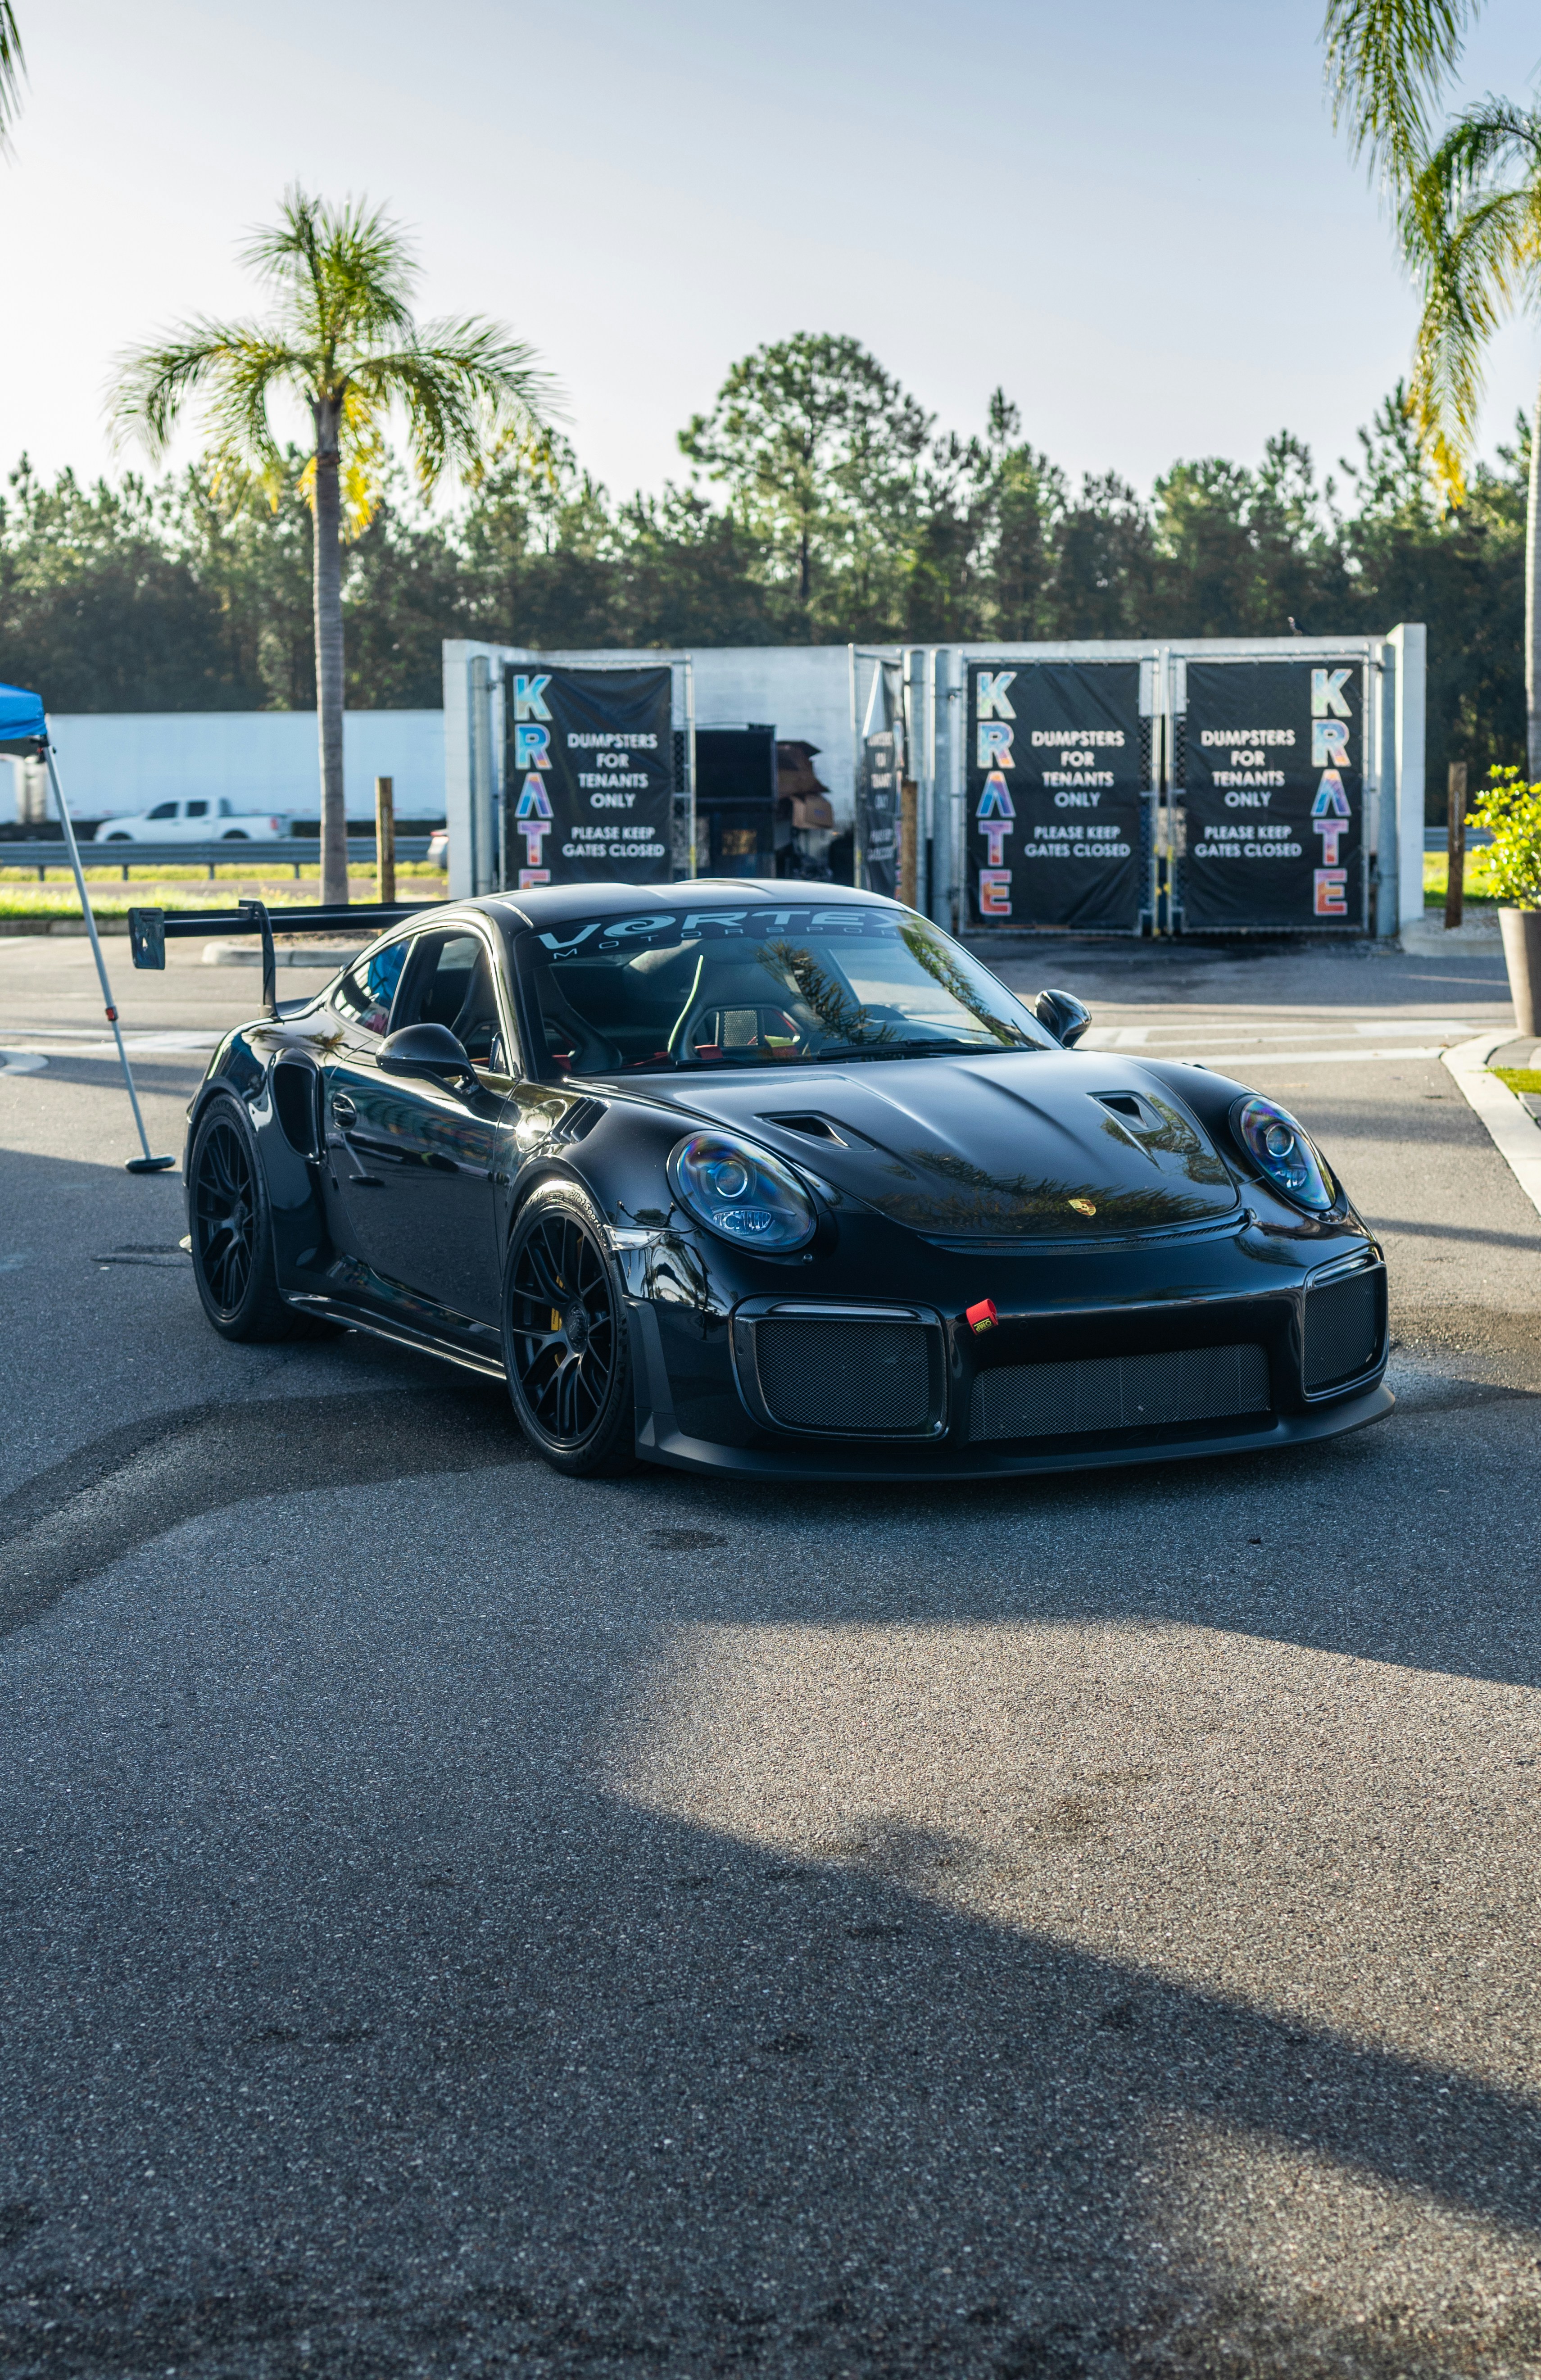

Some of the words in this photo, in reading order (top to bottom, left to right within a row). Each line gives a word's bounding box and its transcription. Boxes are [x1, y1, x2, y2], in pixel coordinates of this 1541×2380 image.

[567, 733, 658, 749] DUMPSTERS
[1032, 731, 1125, 747] DUMPSTERS
[1201, 730, 1296, 746] DUMPSTERS
[596, 753, 629, 768] FOR
[1061, 751, 1095, 767] FOR
[1231, 750, 1265, 766] FOR
[578, 773, 648, 789] TENANTS
[1042, 771, 1115, 787] TENANTS
[1212, 771, 1285, 787] TENANTS
[590, 793, 636, 808] ONLY
[976, 671, 1017, 916] KRATE
[1054, 792, 1101, 807] ONLY
[1224, 792, 1272, 807] ONLY
[1310, 669, 1354, 916] KRATE
[571, 827, 620, 840] PLEASE
[622, 827, 655, 841] KEEP
[1034, 826, 1084, 840] PLEASE
[1086, 826, 1121, 840] KEEP
[1204, 826, 1255, 840] PLEASE
[1257, 826, 1292, 840] KEEP
[562, 843, 606, 857] GATES
[609, 843, 665, 857] CLOSED
[1024, 843, 1070, 858] GATES
[1073, 843, 1131, 858] CLOSED
[1194, 843, 1241, 858] GATES
[1243, 843, 1302, 858] CLOSED
[530, 911, 922, 949] VORTEX
[568, 1189, 586, 1207] Pilot
[584, 1202, 602, 1229] Sport
[976, 1320, 992, 1331] OMP
